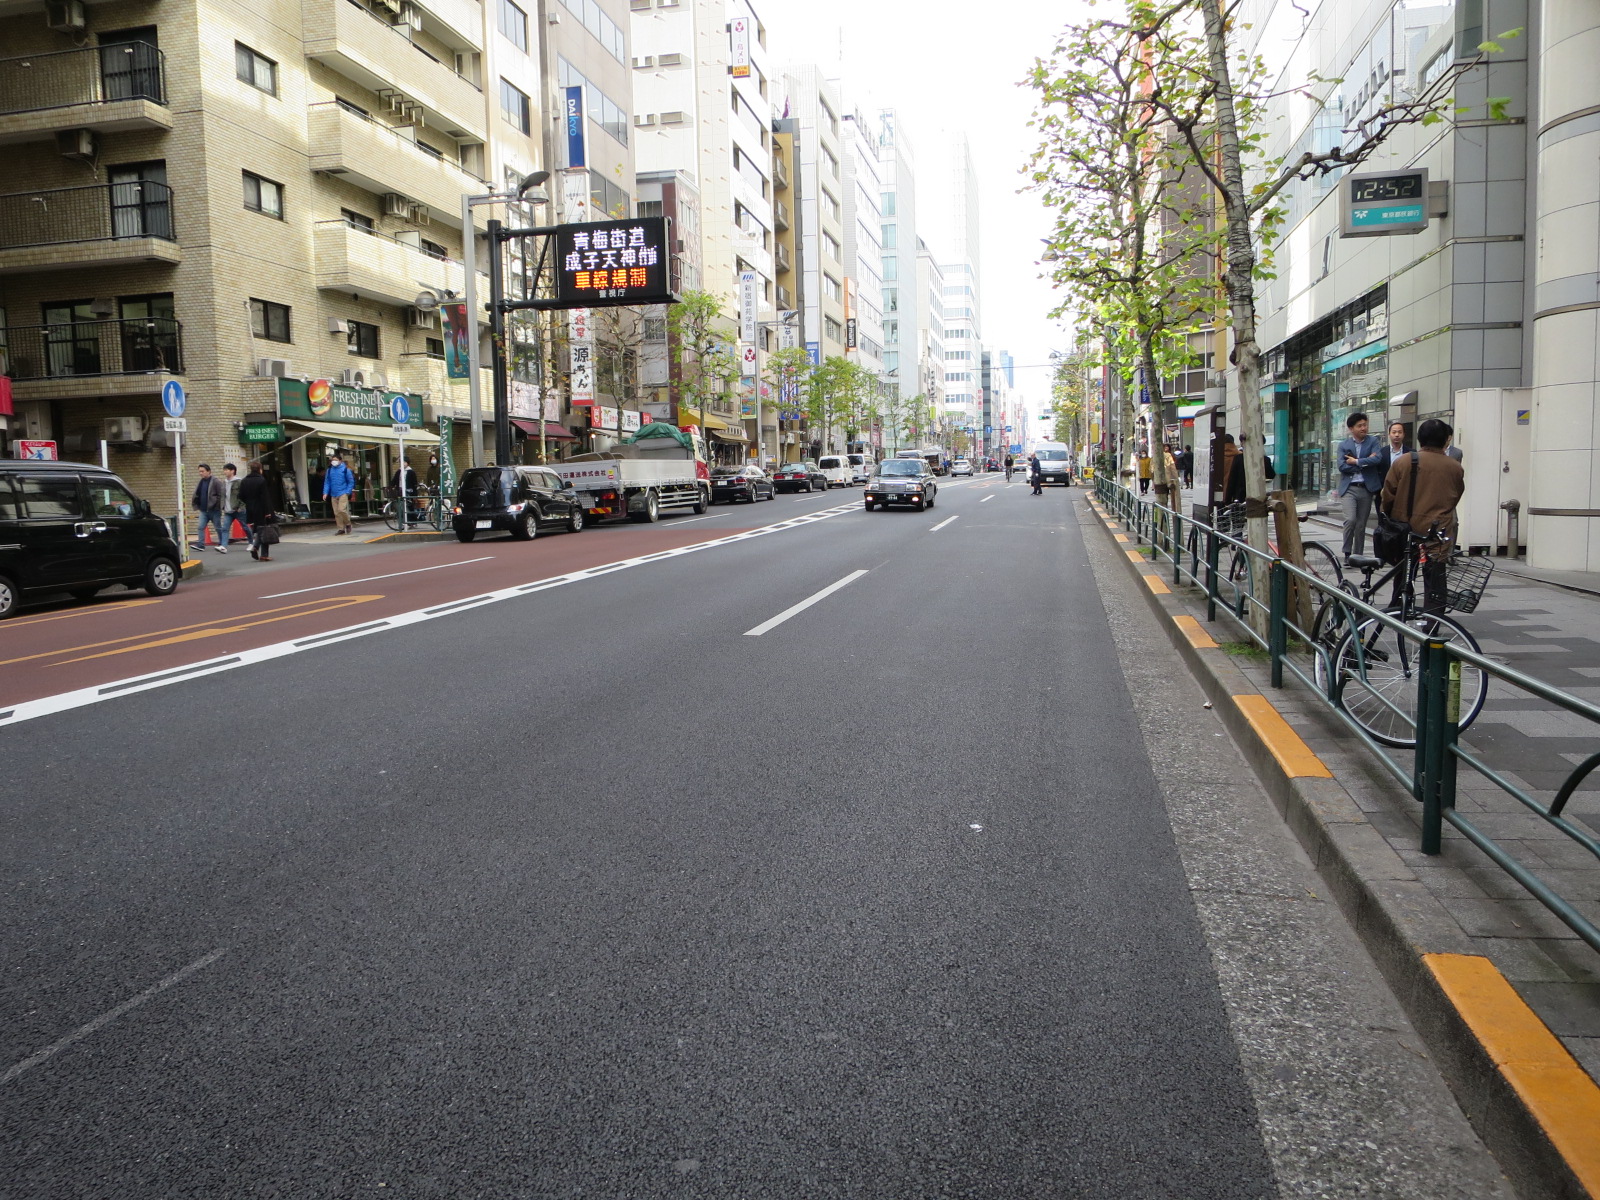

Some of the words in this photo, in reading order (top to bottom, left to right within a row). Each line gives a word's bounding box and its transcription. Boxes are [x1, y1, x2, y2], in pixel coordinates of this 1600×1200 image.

[1356, 178, 1415, 200] 12:52
[573, 226, 646, 251] 青梅街道
[574, 267, 647, 290] 車線規制
[573, 347, 590, 389] 源ちゃん
[333, 389, 385, 406] FRESHNES
